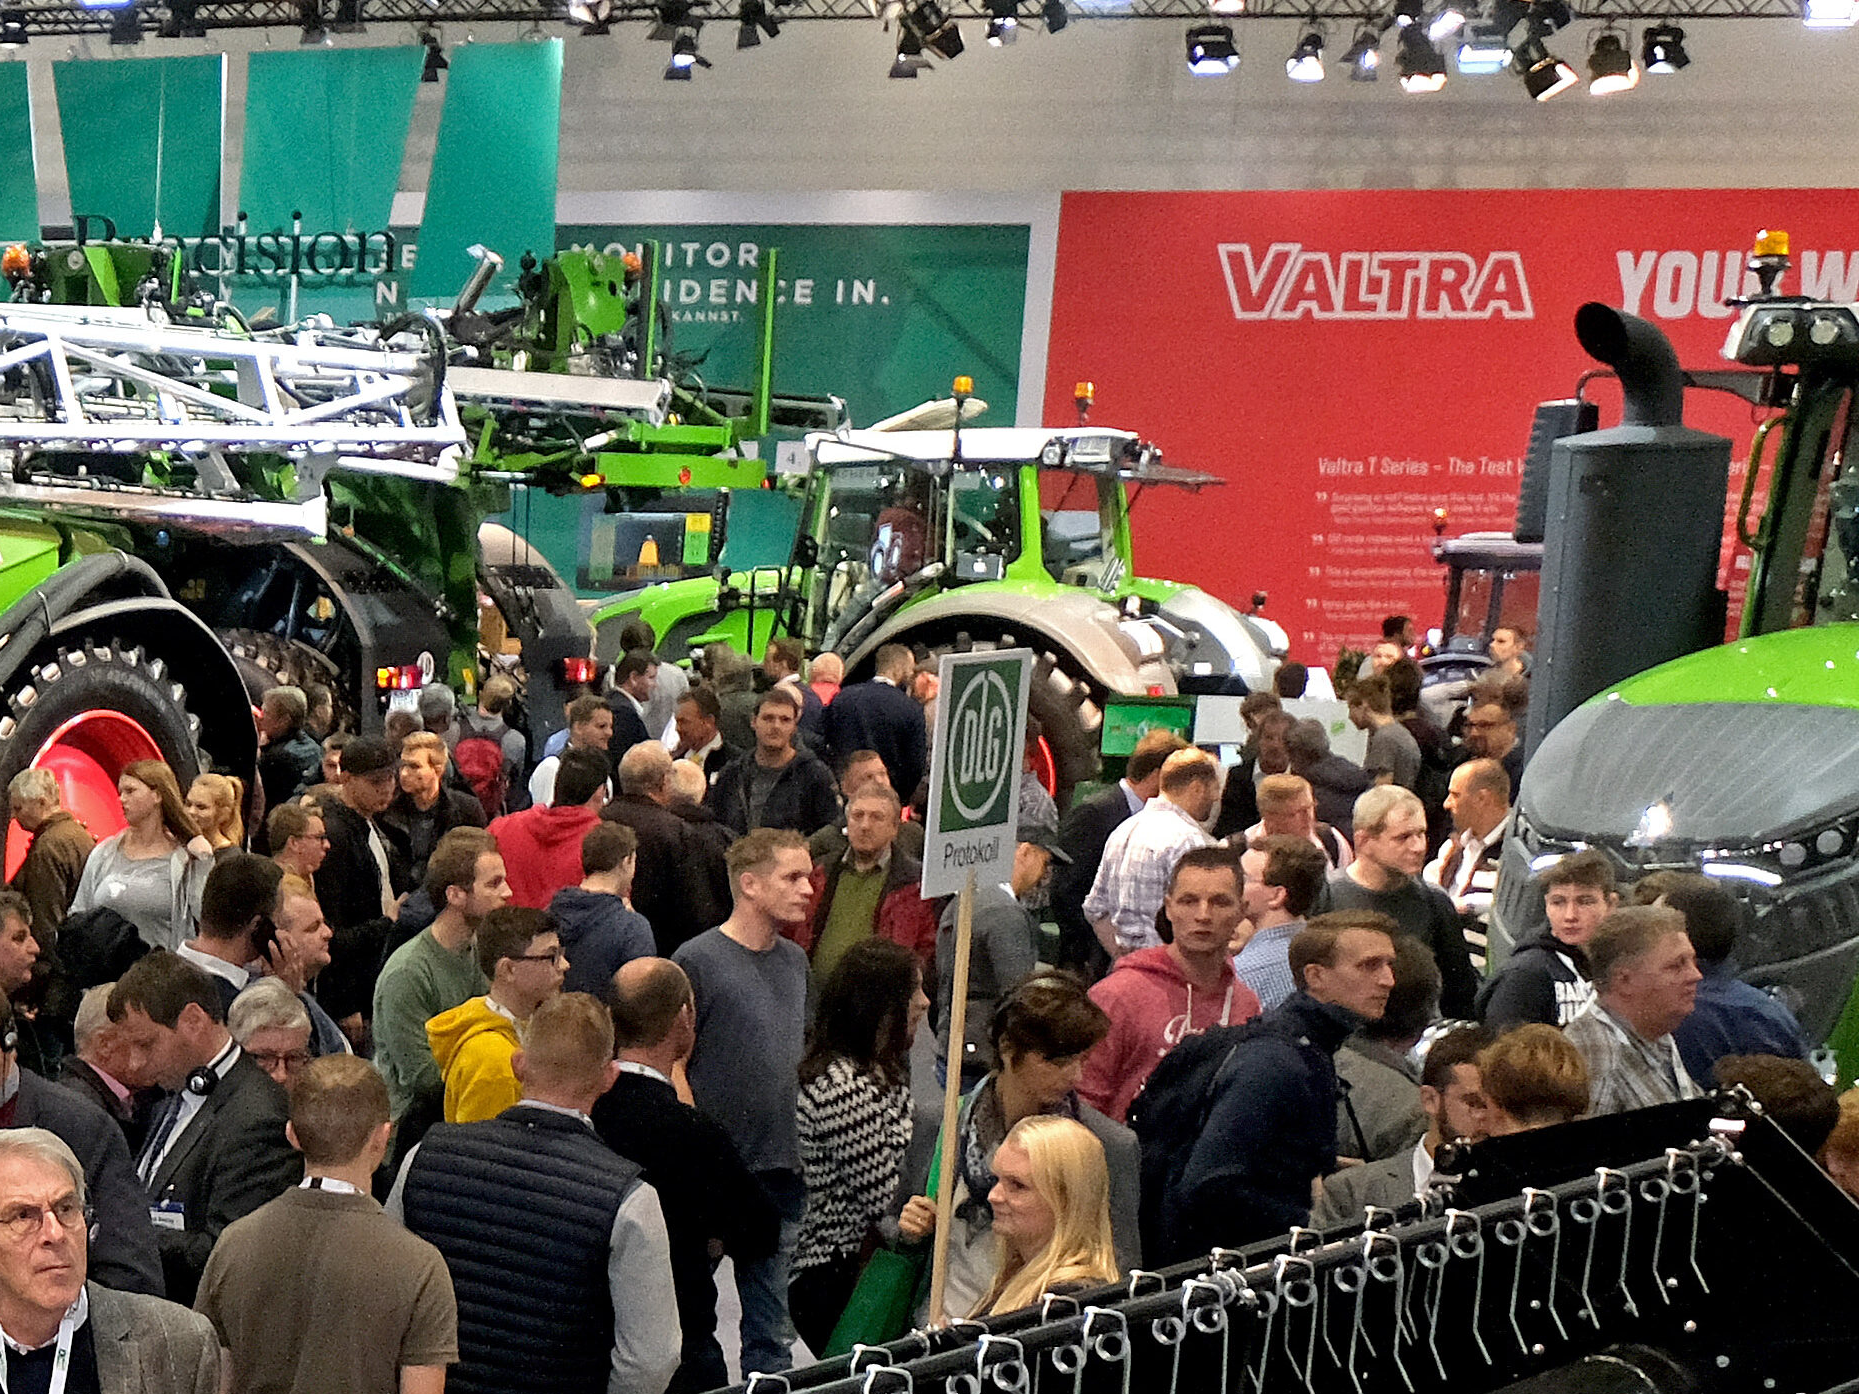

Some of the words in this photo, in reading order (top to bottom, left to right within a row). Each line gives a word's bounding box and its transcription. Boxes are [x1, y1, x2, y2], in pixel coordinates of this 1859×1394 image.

[835, 278, 890, 304] IN.
[1216, 242, 1535, 321] VALTRA
[959, 673, 1002, 785] DLG
[943, 836, 1000, 869] Protokoll
